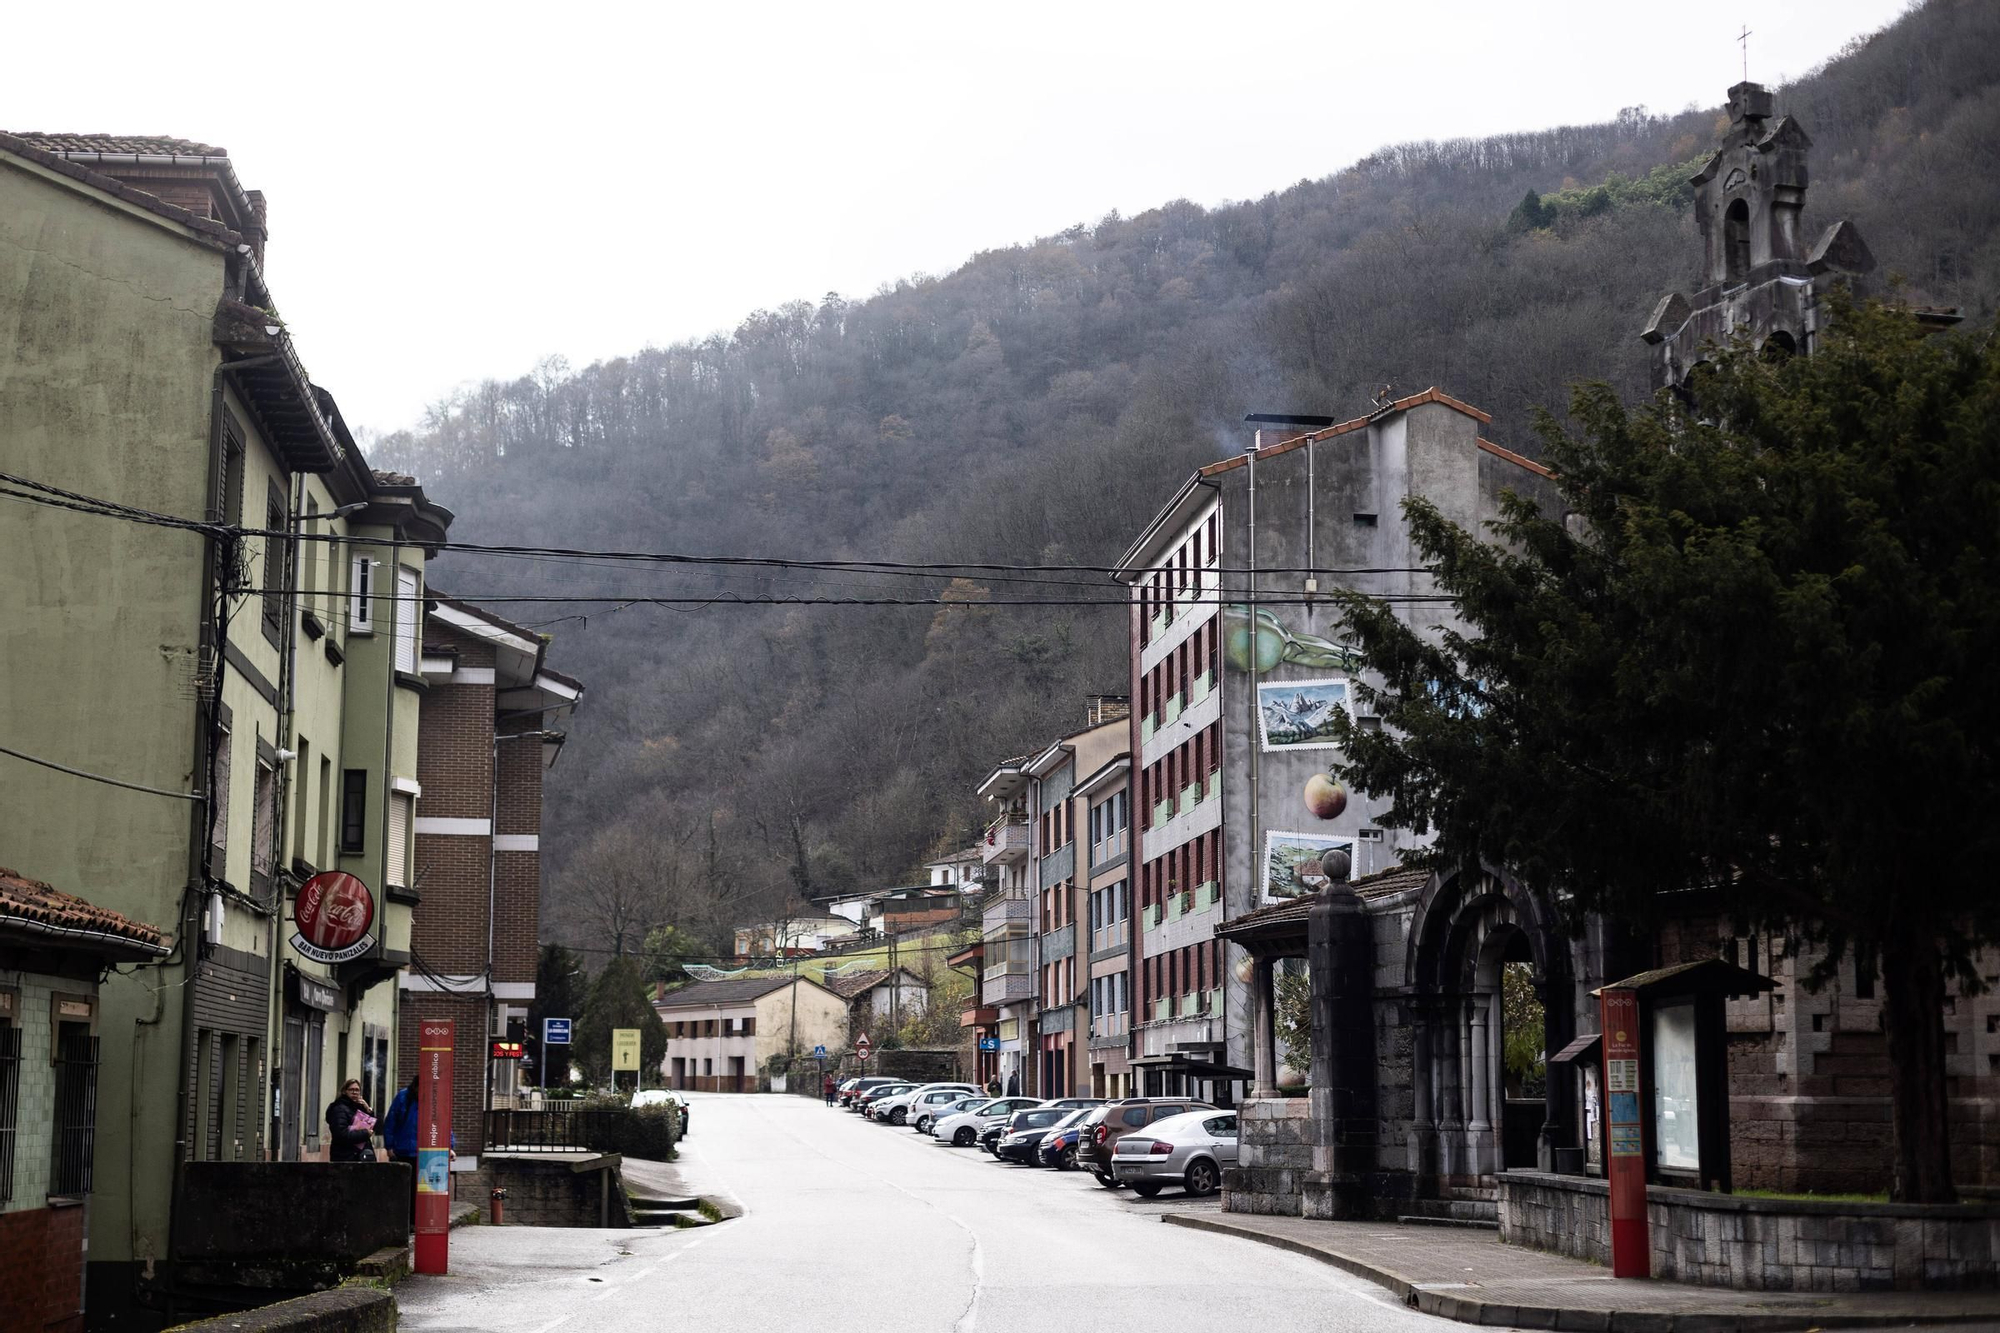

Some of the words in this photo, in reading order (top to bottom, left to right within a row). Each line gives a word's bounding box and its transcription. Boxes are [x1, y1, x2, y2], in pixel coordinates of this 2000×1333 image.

[299, 879, 325, 924] Coca-Cola
[297, 941, 312, 954] BAR
[311, 949, 334, 960] NUEVO
[335, 941, 368, 960] PANIZALES
[431, 1053, 440, 1080] público
[430, 1123, 438, 1146] mejor
